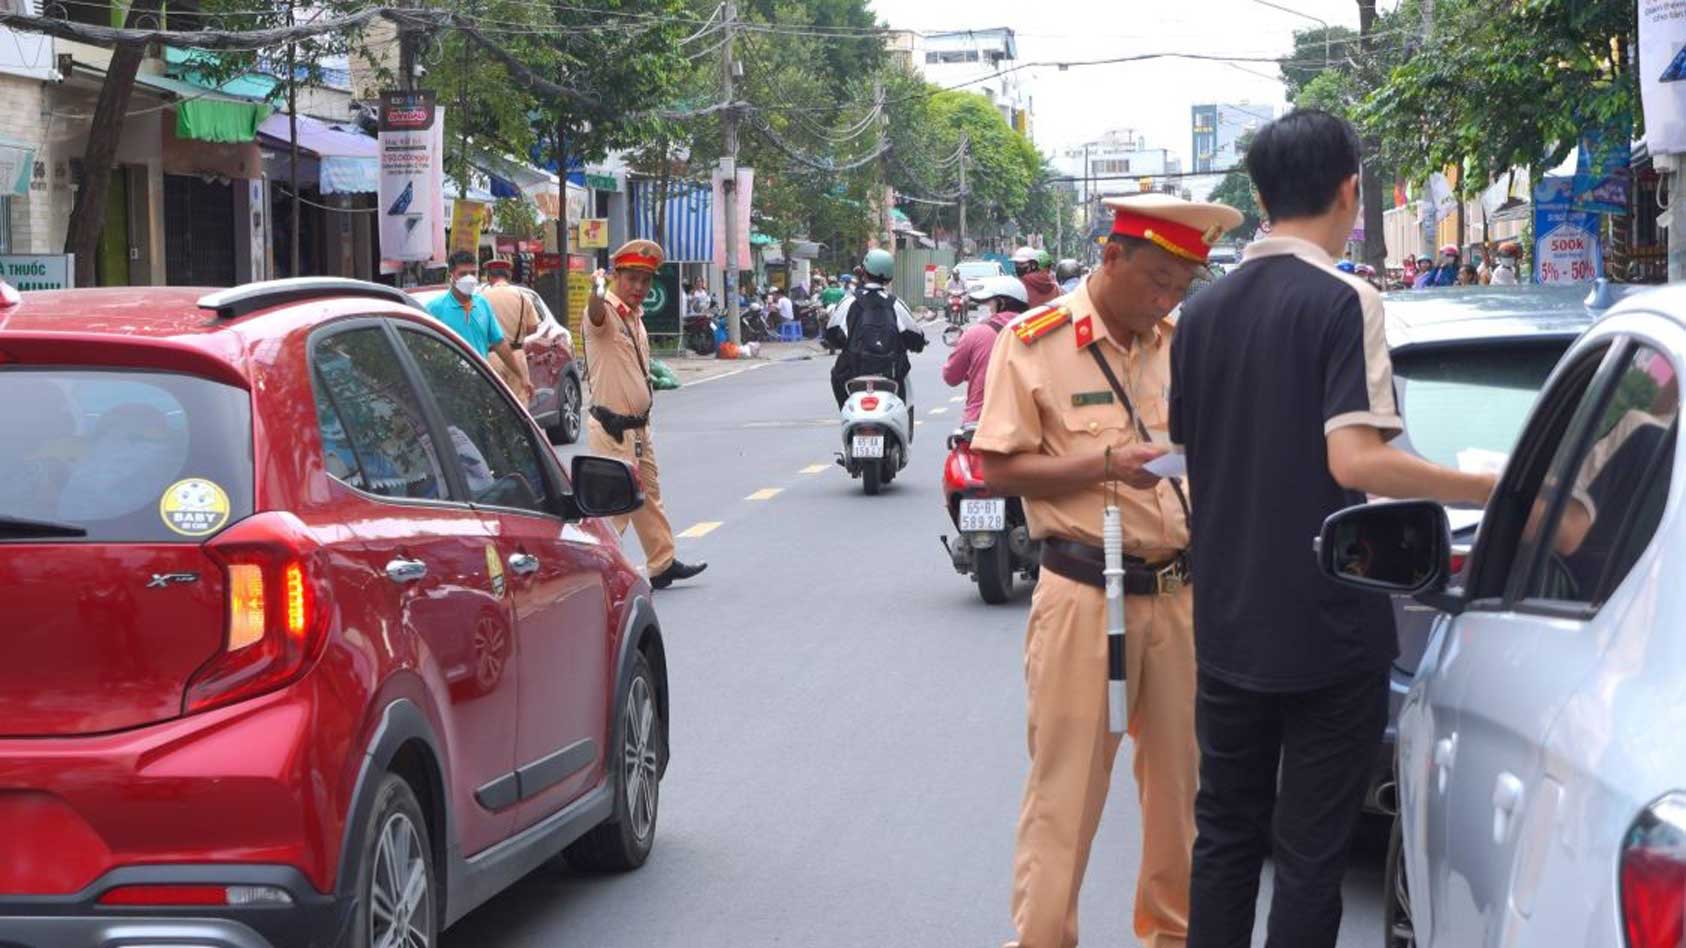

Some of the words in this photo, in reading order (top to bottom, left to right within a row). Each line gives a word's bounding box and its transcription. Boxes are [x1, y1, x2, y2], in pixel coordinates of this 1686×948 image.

[1541, 260, 1560, 281] 5%
[1571, 258, 1596, 280] 50%
[173, 512, 217, 523] BABY
